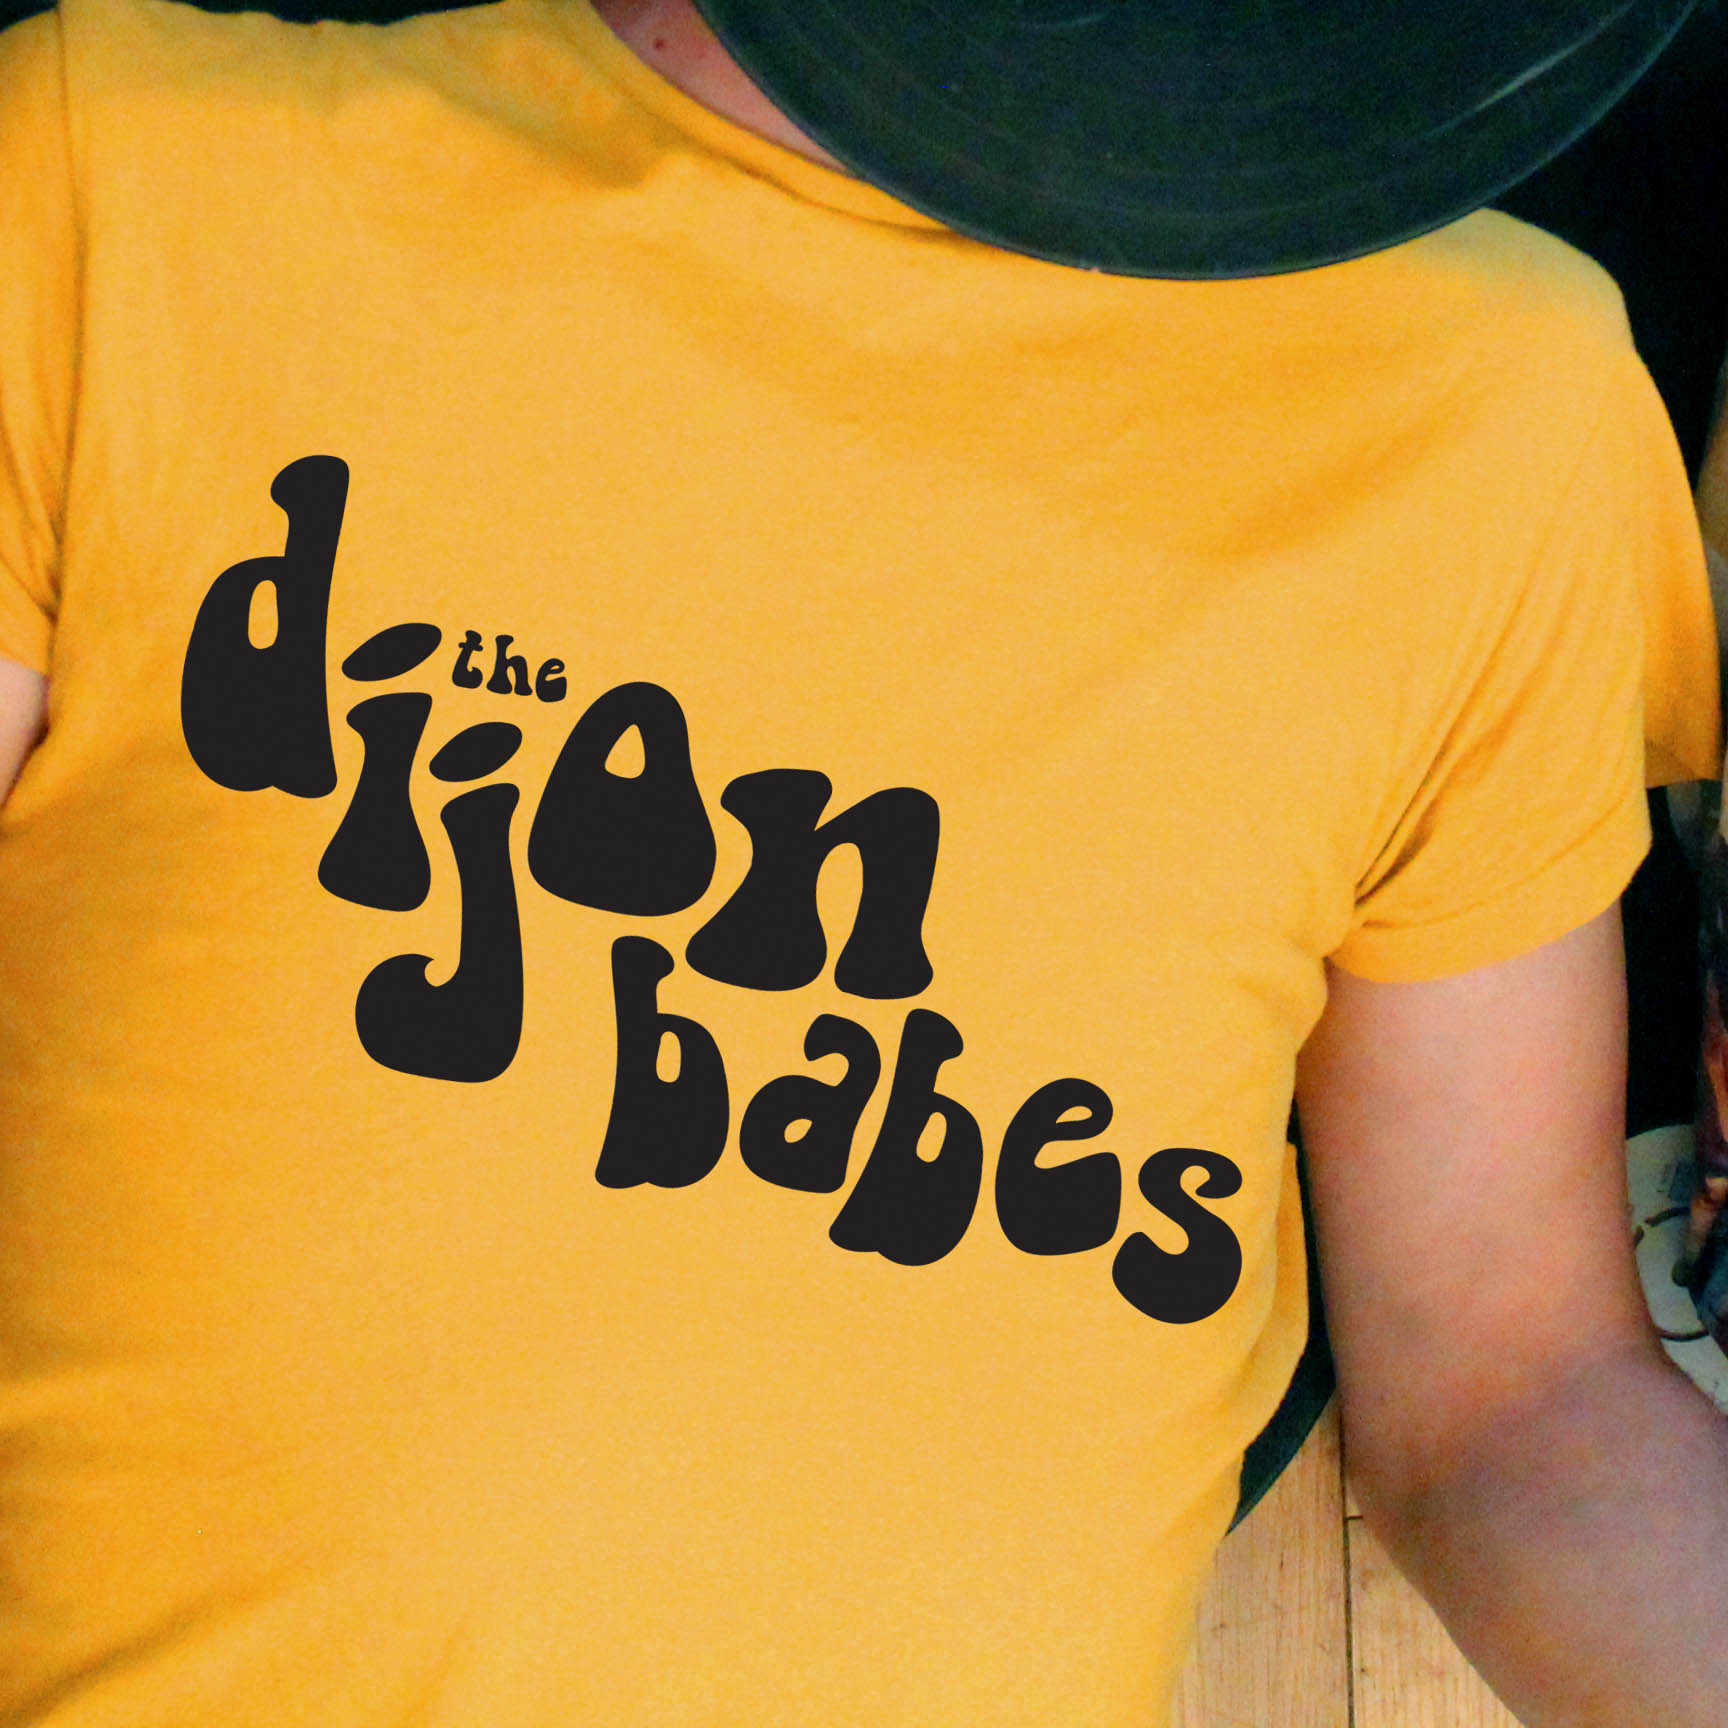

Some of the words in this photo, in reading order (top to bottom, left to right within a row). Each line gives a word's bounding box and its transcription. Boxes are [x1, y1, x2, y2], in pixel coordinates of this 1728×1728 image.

[180, 453, 942, 1084] dijon
[450, 629, 569, 703] the
[594, 935, 1243, 1325] babes
